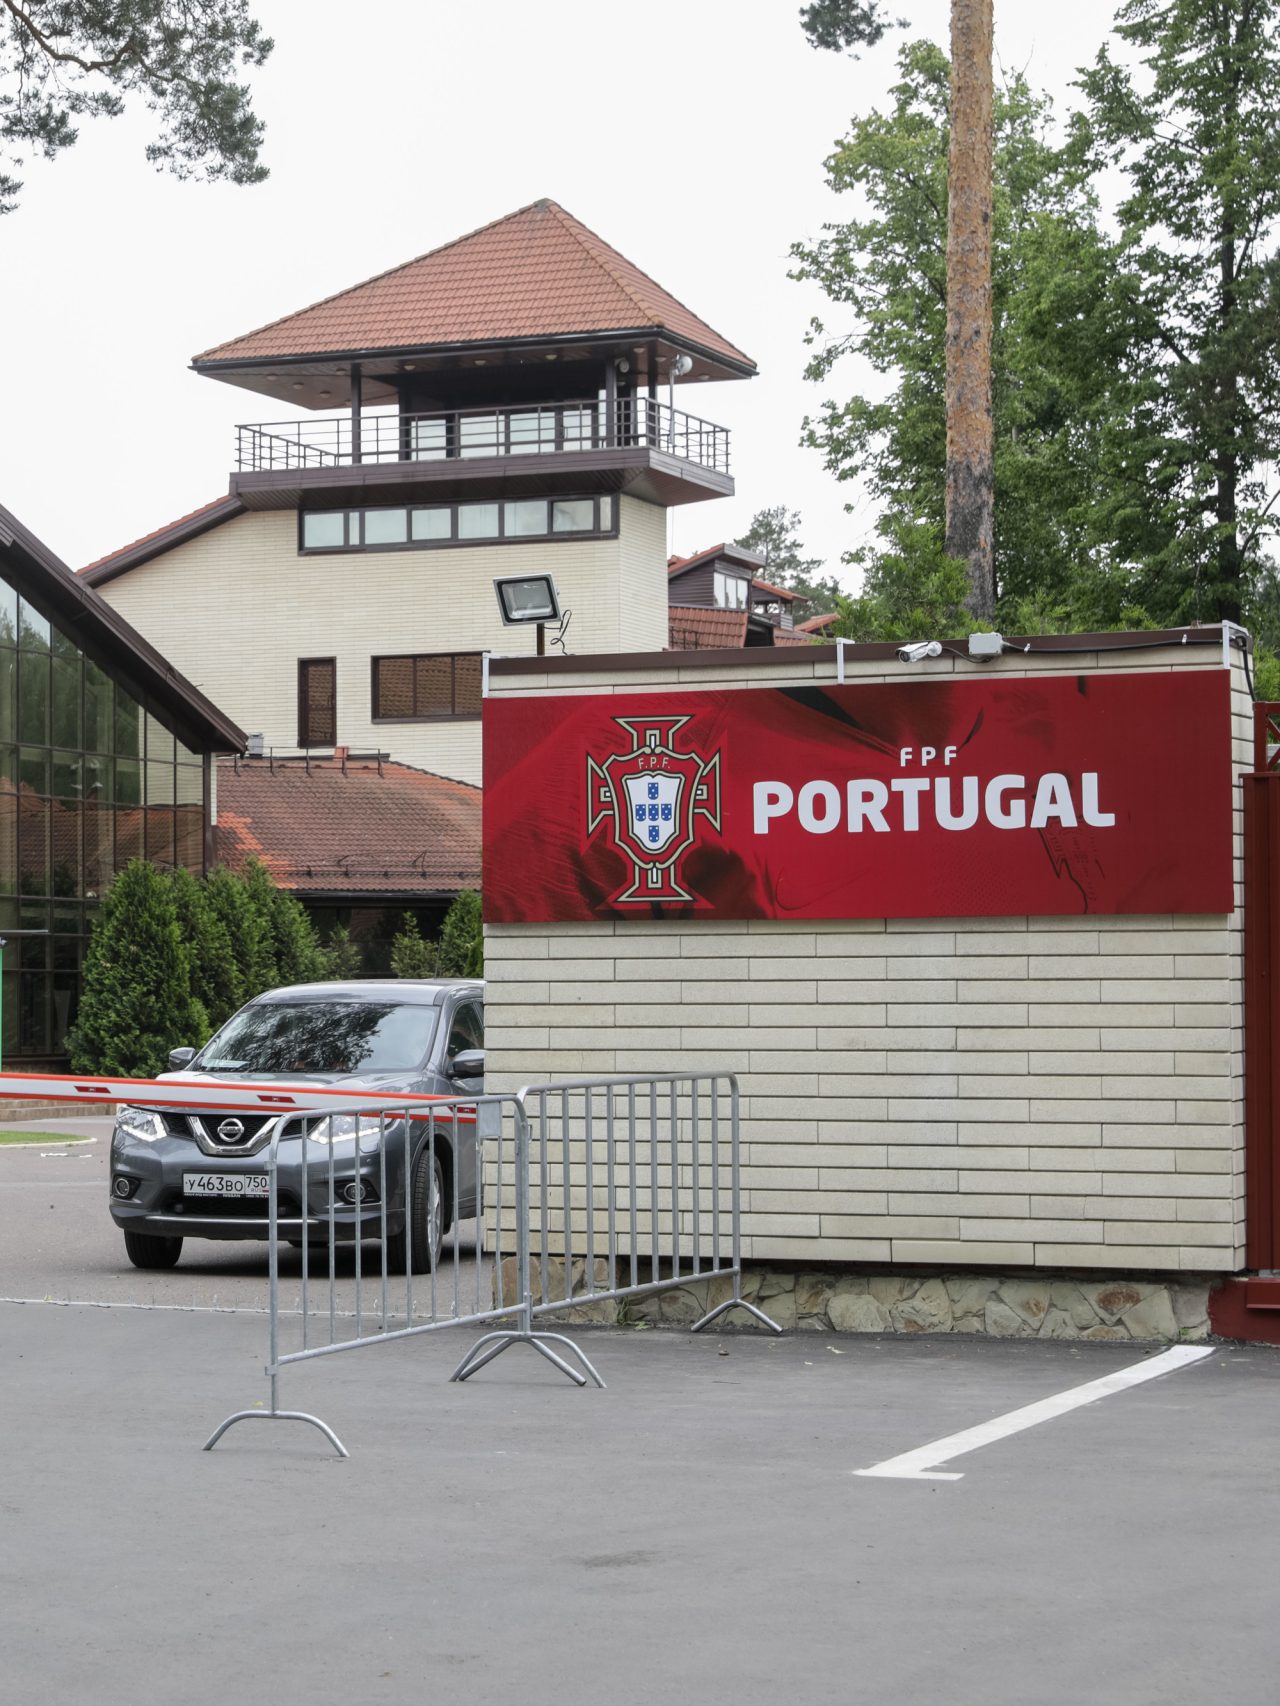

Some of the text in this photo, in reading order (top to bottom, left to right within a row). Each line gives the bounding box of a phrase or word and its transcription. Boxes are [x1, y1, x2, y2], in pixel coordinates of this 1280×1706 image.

[638, 756, 671, 769] F.P.F.
[753, 772, 1115, 835] PORTUGAL
[246, 1176, 267, 1188] 750
